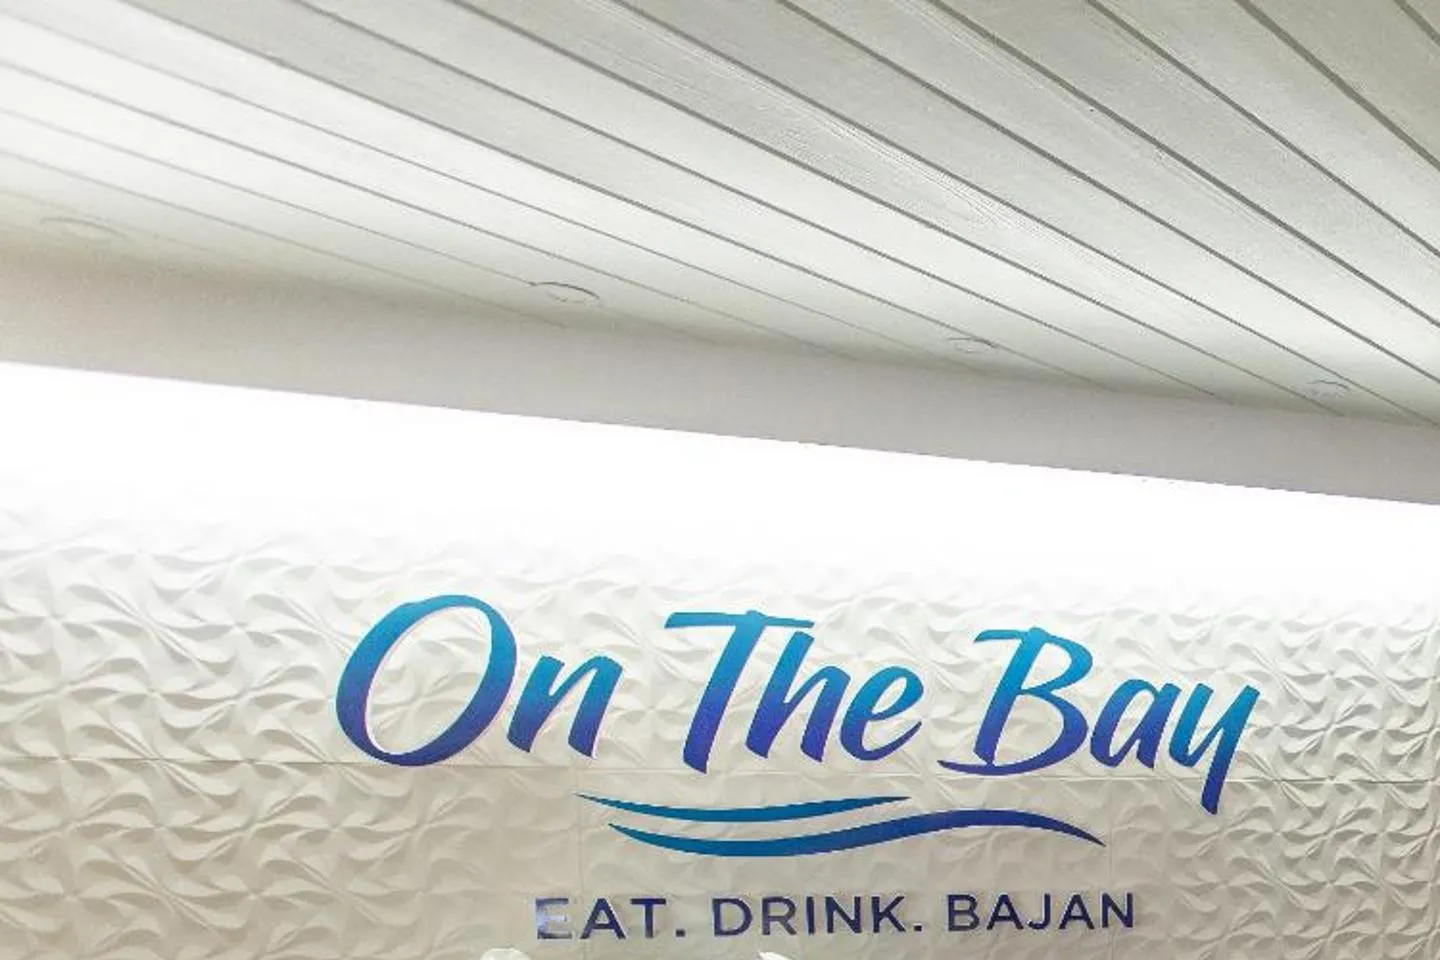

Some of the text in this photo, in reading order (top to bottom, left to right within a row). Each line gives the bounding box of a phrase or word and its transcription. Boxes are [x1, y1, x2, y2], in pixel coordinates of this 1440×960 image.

[334, 592, 1261, 815] On The Bay
[536, 892, 1134, 940] EAT. DRINK. BAJAN
